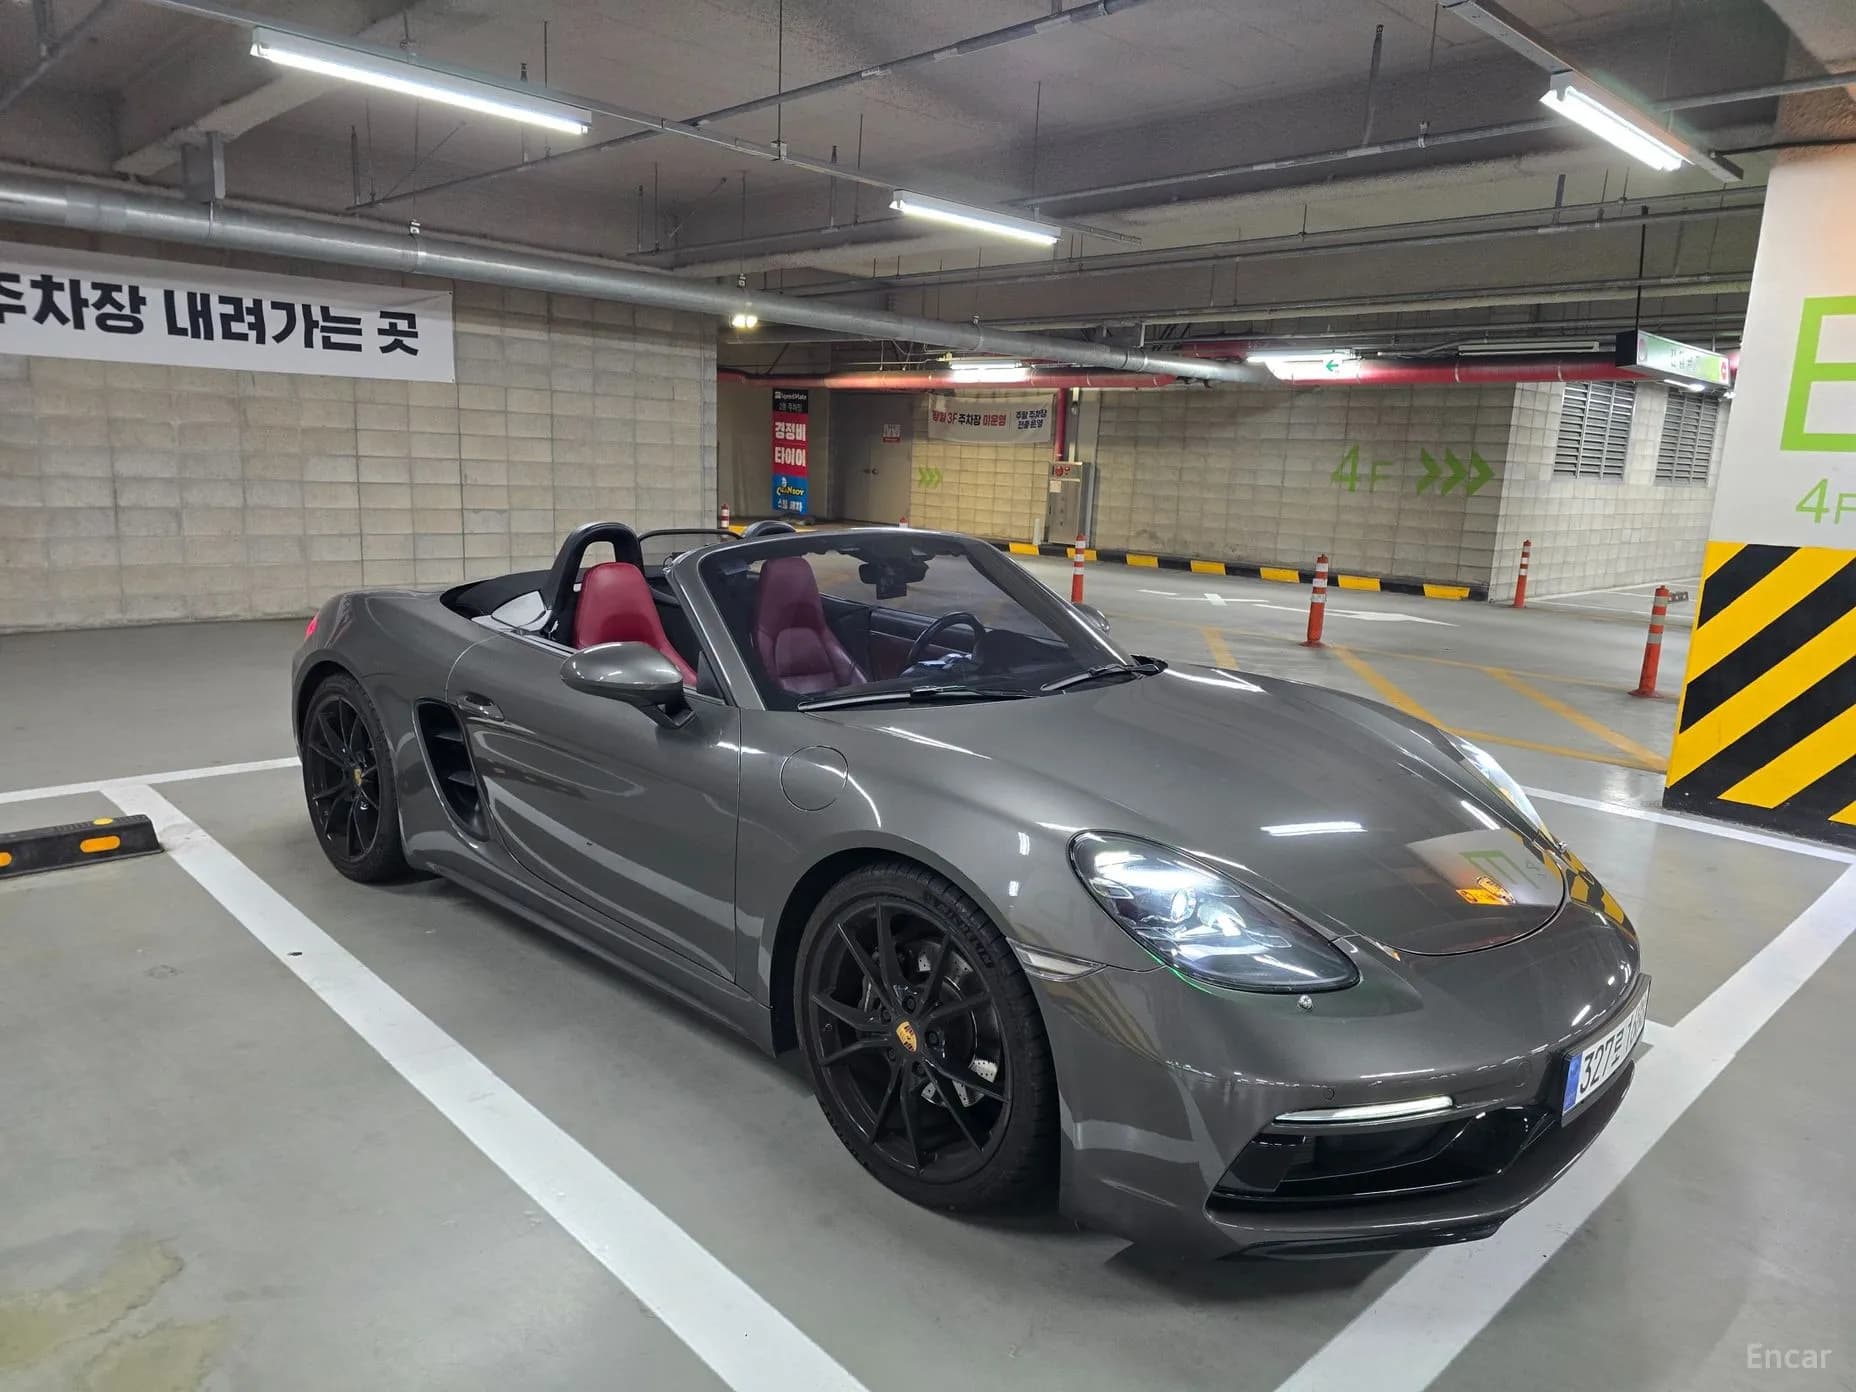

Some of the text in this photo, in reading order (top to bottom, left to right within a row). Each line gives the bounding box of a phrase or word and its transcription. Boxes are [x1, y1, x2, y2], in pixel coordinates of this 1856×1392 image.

[163, 289, 364, 353] 내려가는
[376, 310, 419, 356] 곳
[775, 421, 806, 441] 경정비
[958, 413, 981, 426] 주차장
[1330, 444, 1393, 495] 4F
